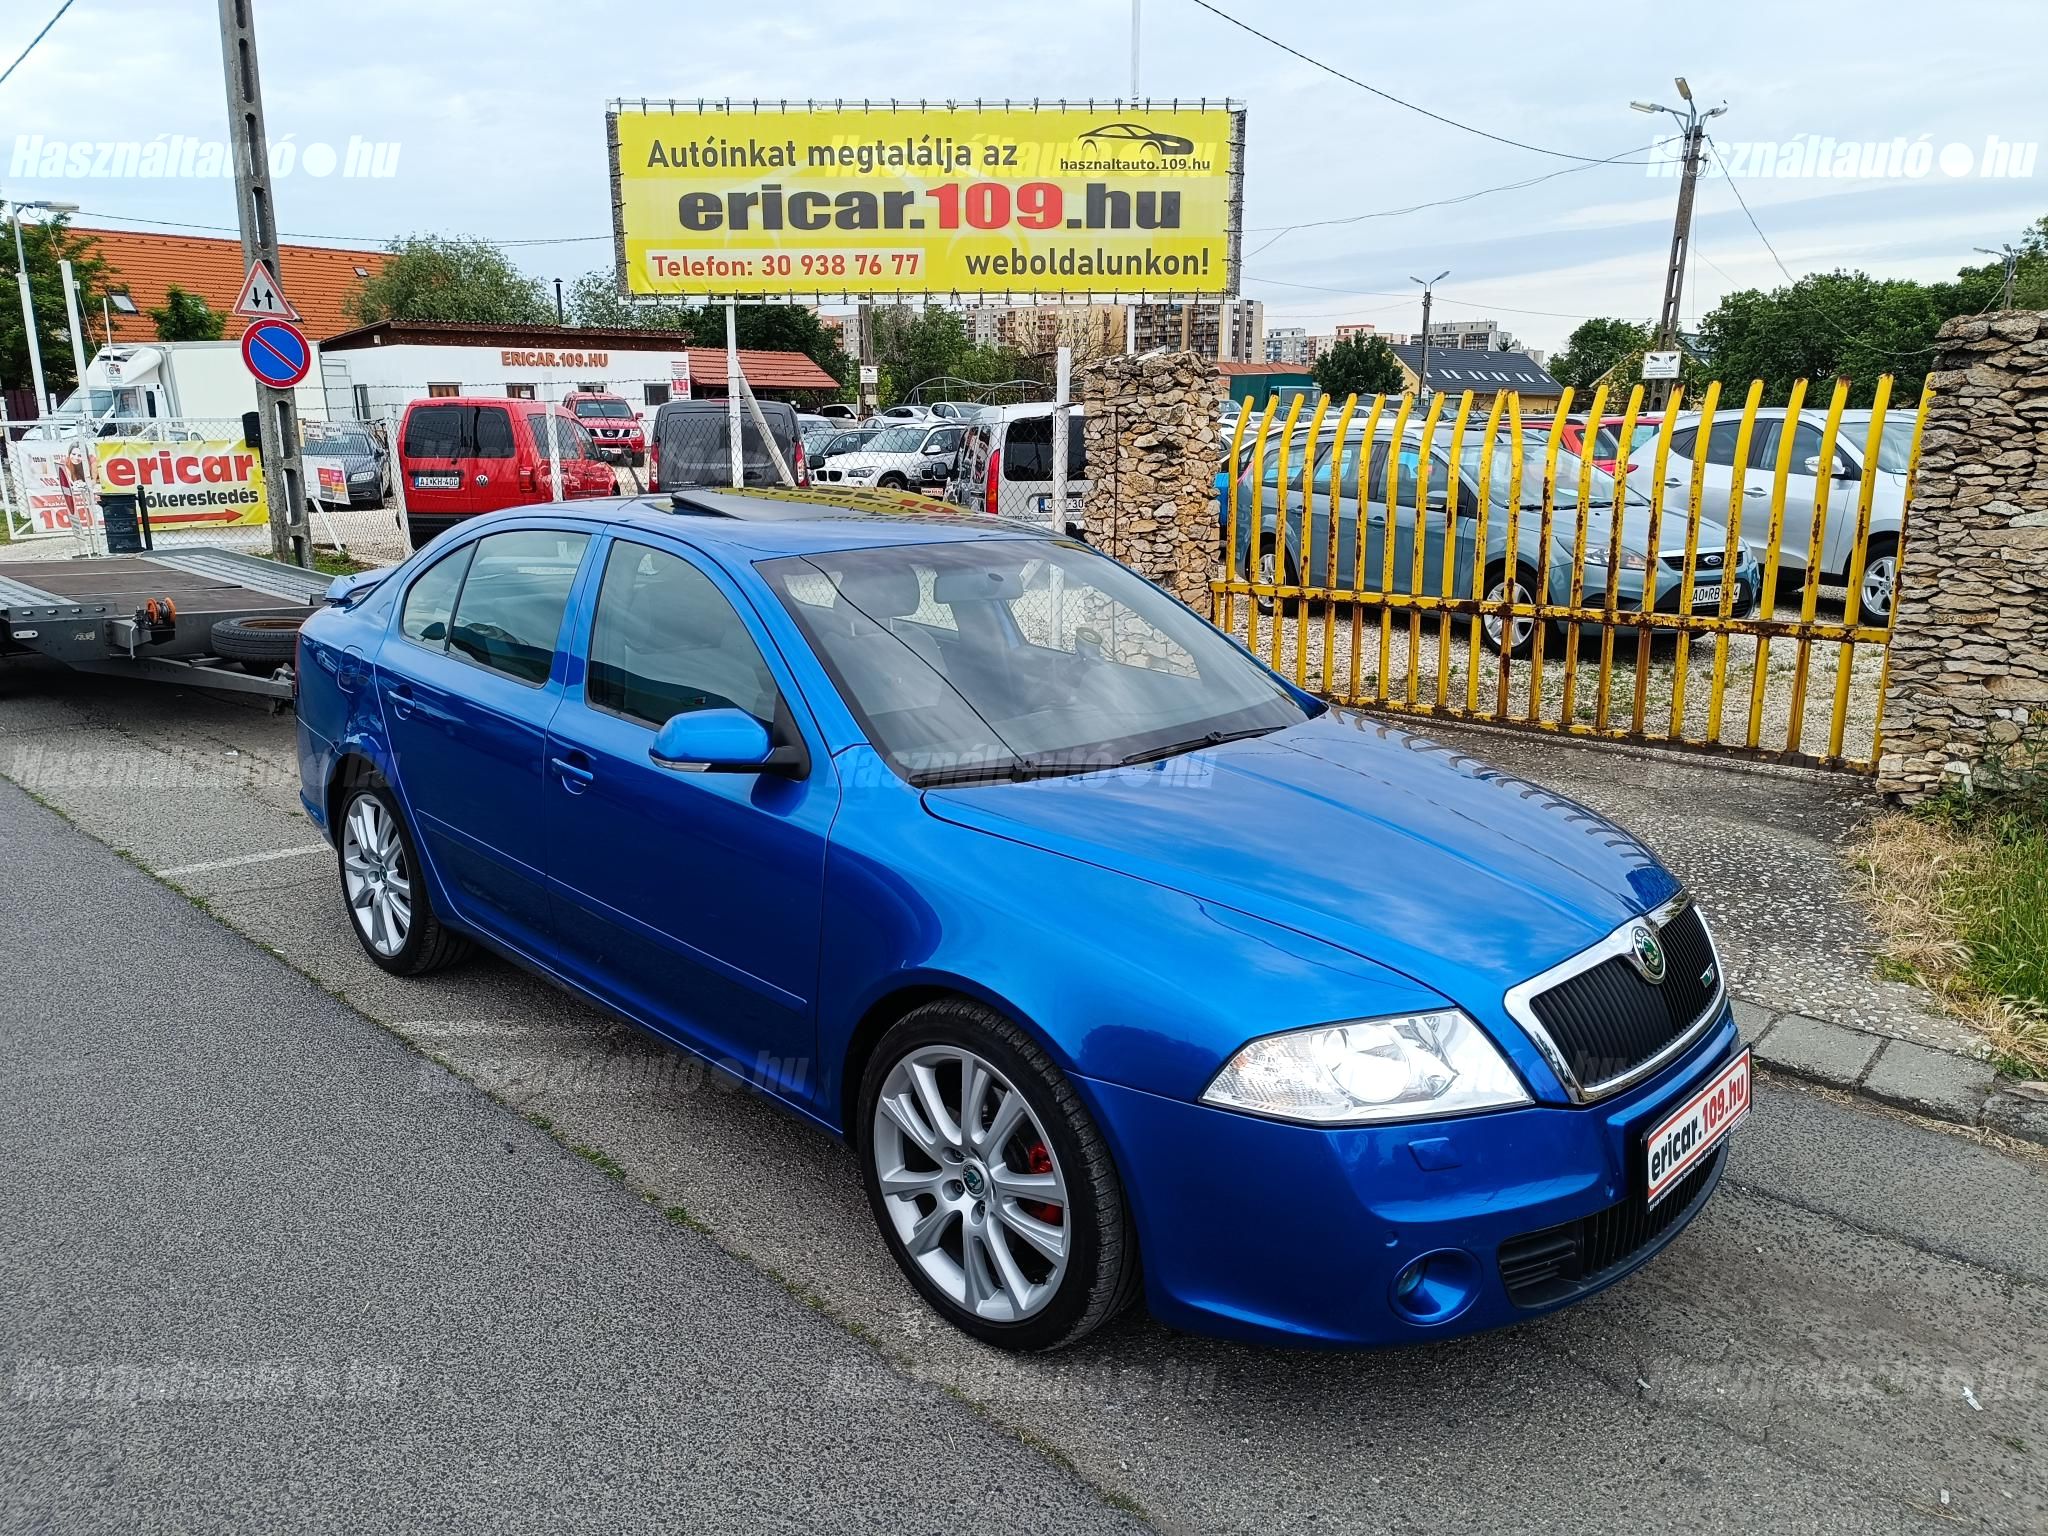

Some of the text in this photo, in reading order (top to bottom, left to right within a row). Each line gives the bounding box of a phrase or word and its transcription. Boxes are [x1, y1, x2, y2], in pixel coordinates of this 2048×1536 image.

[648, 134, 1018, 174] Autóinkat megtalálja az
[1060, 158, 1211, 171] hasznaltauto.109.hu
[679, 182, 1181, 231] ericar.109.hu
[652, 254, 919, 277] Telefon: 30 938 76 77
[966, 248, 1209, 276] weboldalunkon!
[501, 351, 609, 368] ERICAR.109.HU
[106, 451, 254, 487] ericar
[145, 487, 259, 509] ókereskedés
[1651, 1072, 1745, 1182] ericar.109.hu
